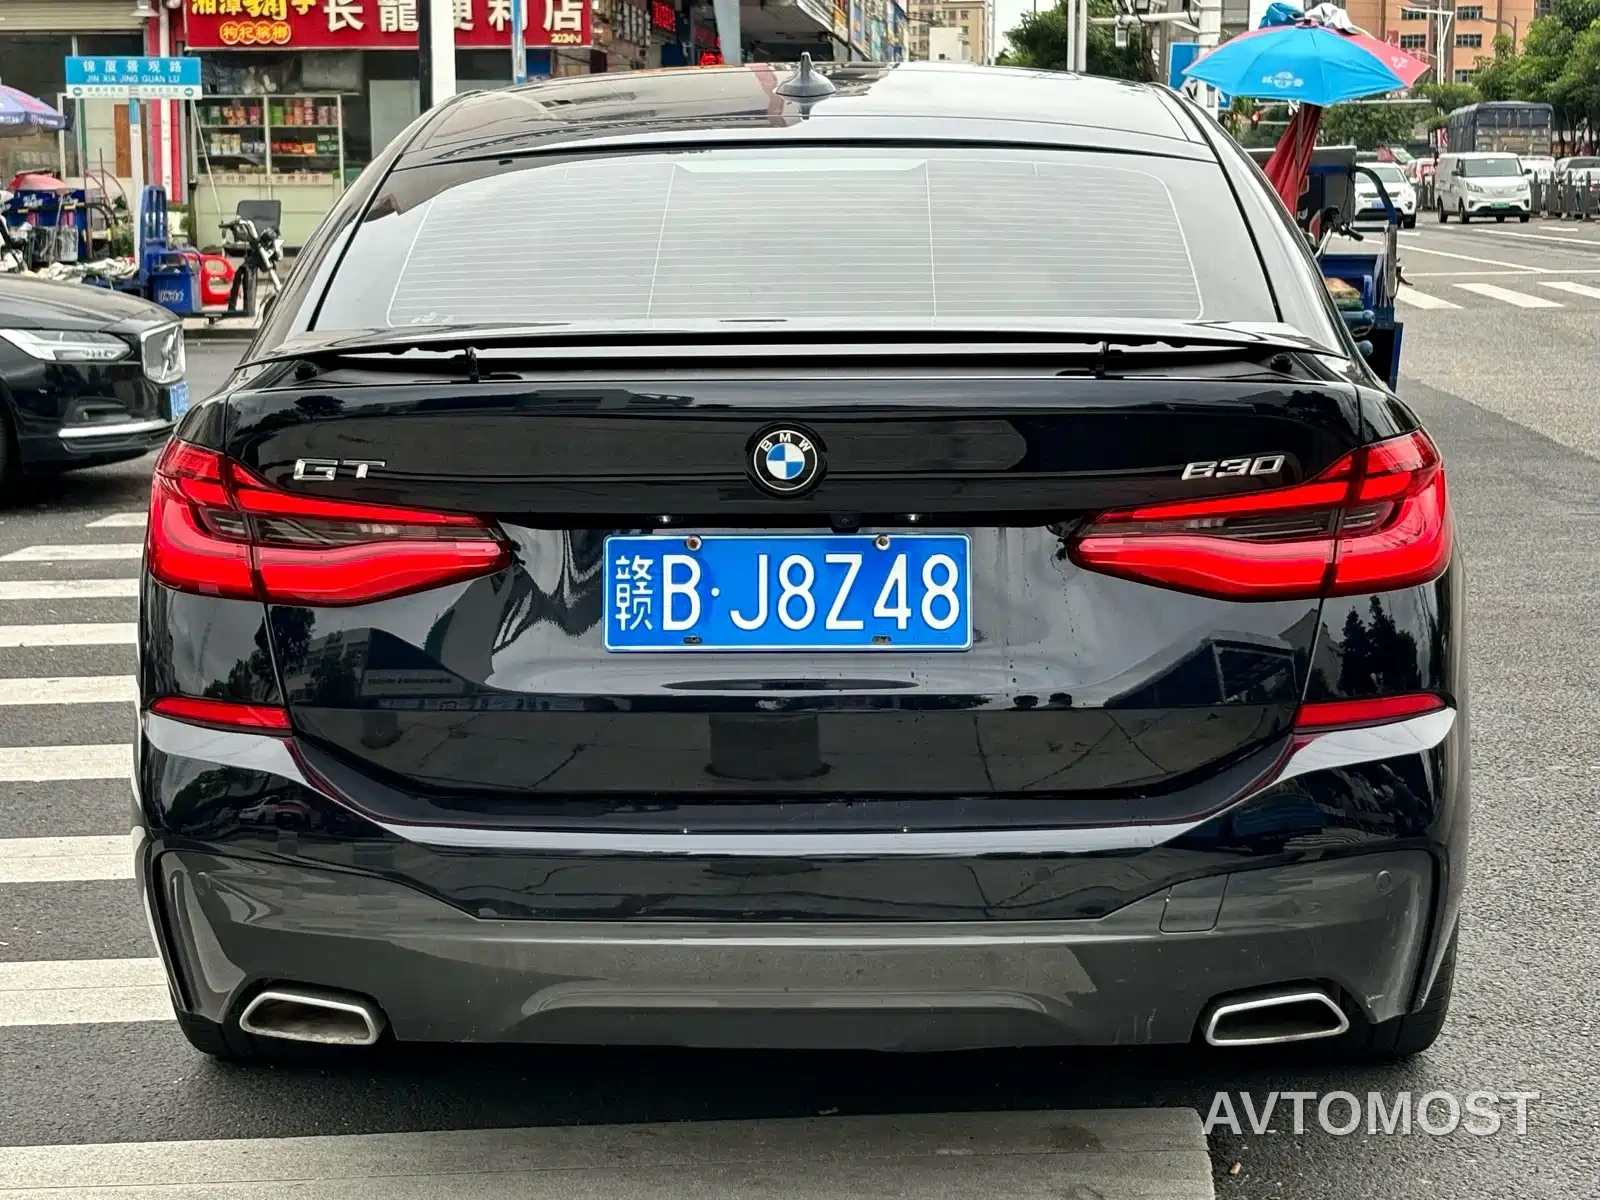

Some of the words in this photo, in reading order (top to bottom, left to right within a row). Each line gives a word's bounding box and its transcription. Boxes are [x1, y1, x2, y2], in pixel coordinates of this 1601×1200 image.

[83, 60, 182, 73] 锦厦景观路
[86, 75, 100, 83] JIN
[103, 75, 116, 83] XIA
[120, 75, 139, 83] JING
[141, 75, 166, 83] GUAN
[168, 75, 180, 83] LU
[760, 433, 812, 452] BMW
[293, 458, 386, 480] GT
[1181, 455, 1285, 480] 630
